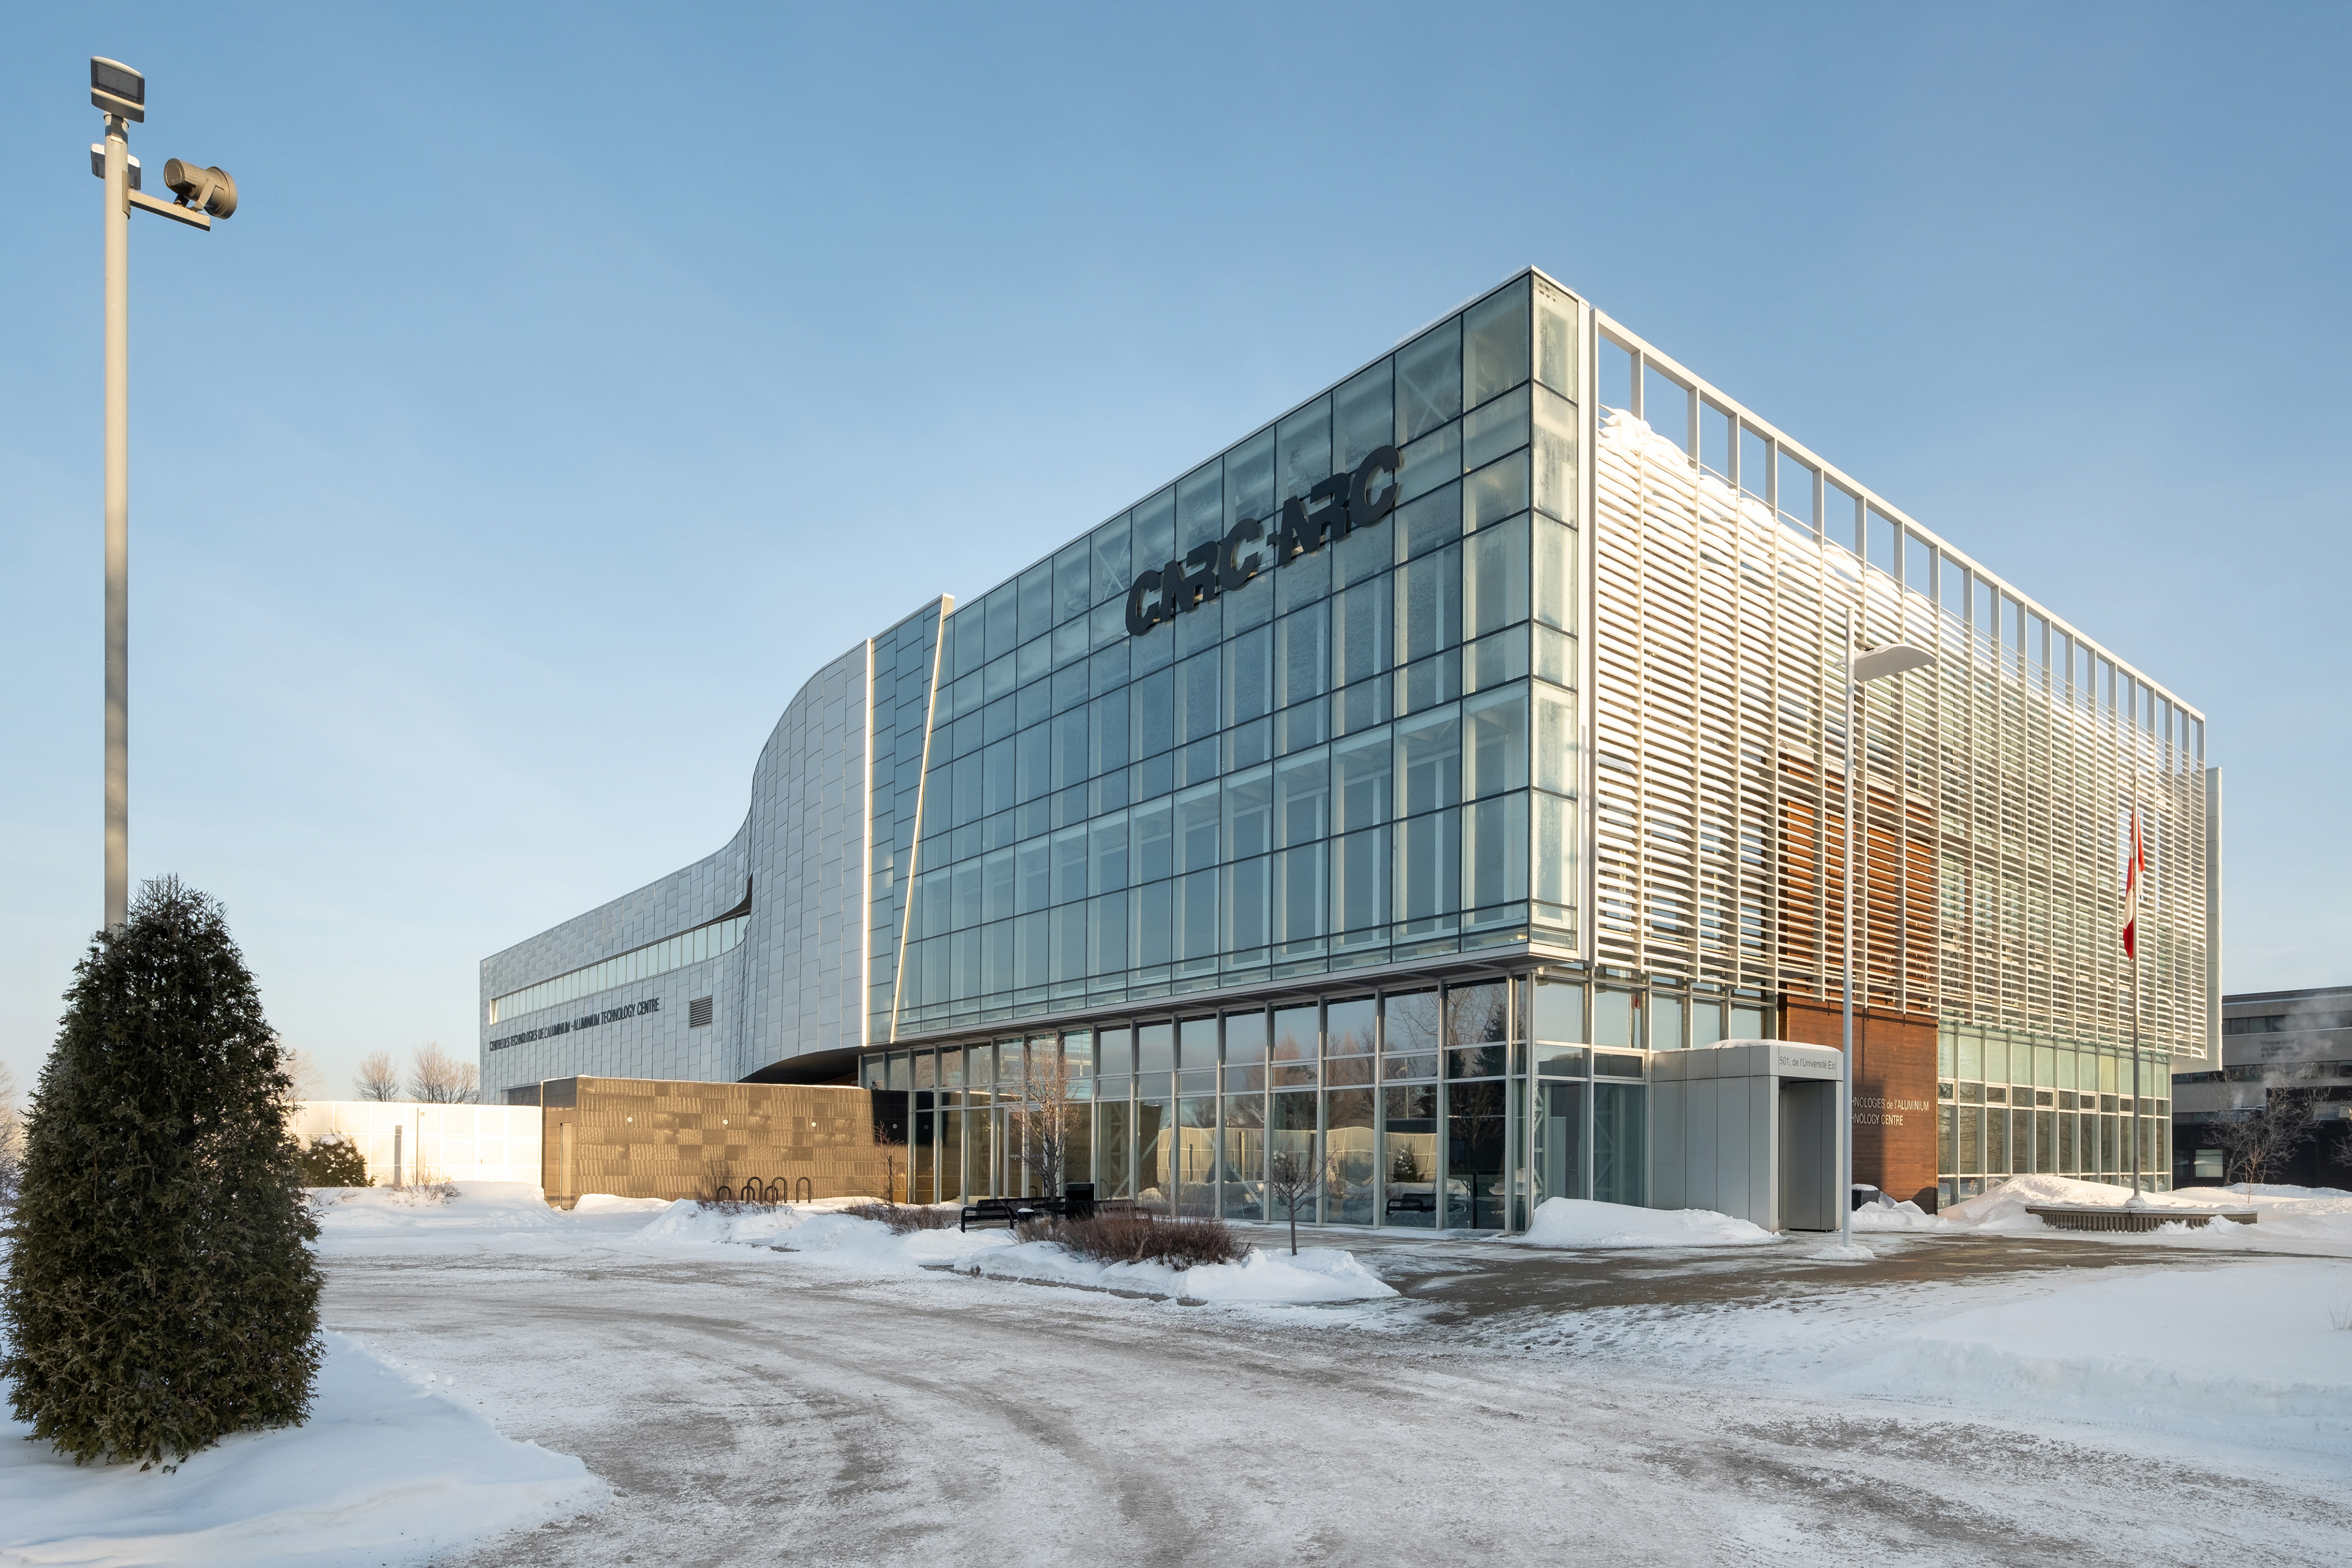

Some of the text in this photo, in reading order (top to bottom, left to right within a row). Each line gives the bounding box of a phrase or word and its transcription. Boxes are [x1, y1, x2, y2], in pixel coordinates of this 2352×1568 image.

[490, 1038, 502, 1051] CENTRE
[510, 1029, 538, 1046] TECHNOLOGIES
[538, 1028, 544, 1039] DE
[601, 1003, 636, 1025] TECHNOLOGY
[637, 997, 660, 1016] CENTRE
[1779, 1056, 1836, 1070] 501, de l'Université Est
[1886, 1099, 1893, 1109] de
[1894, 1099, 1929, 1111] l'ALUMINIUM
[1881, 1114, 1904, 1126] CENTRE
